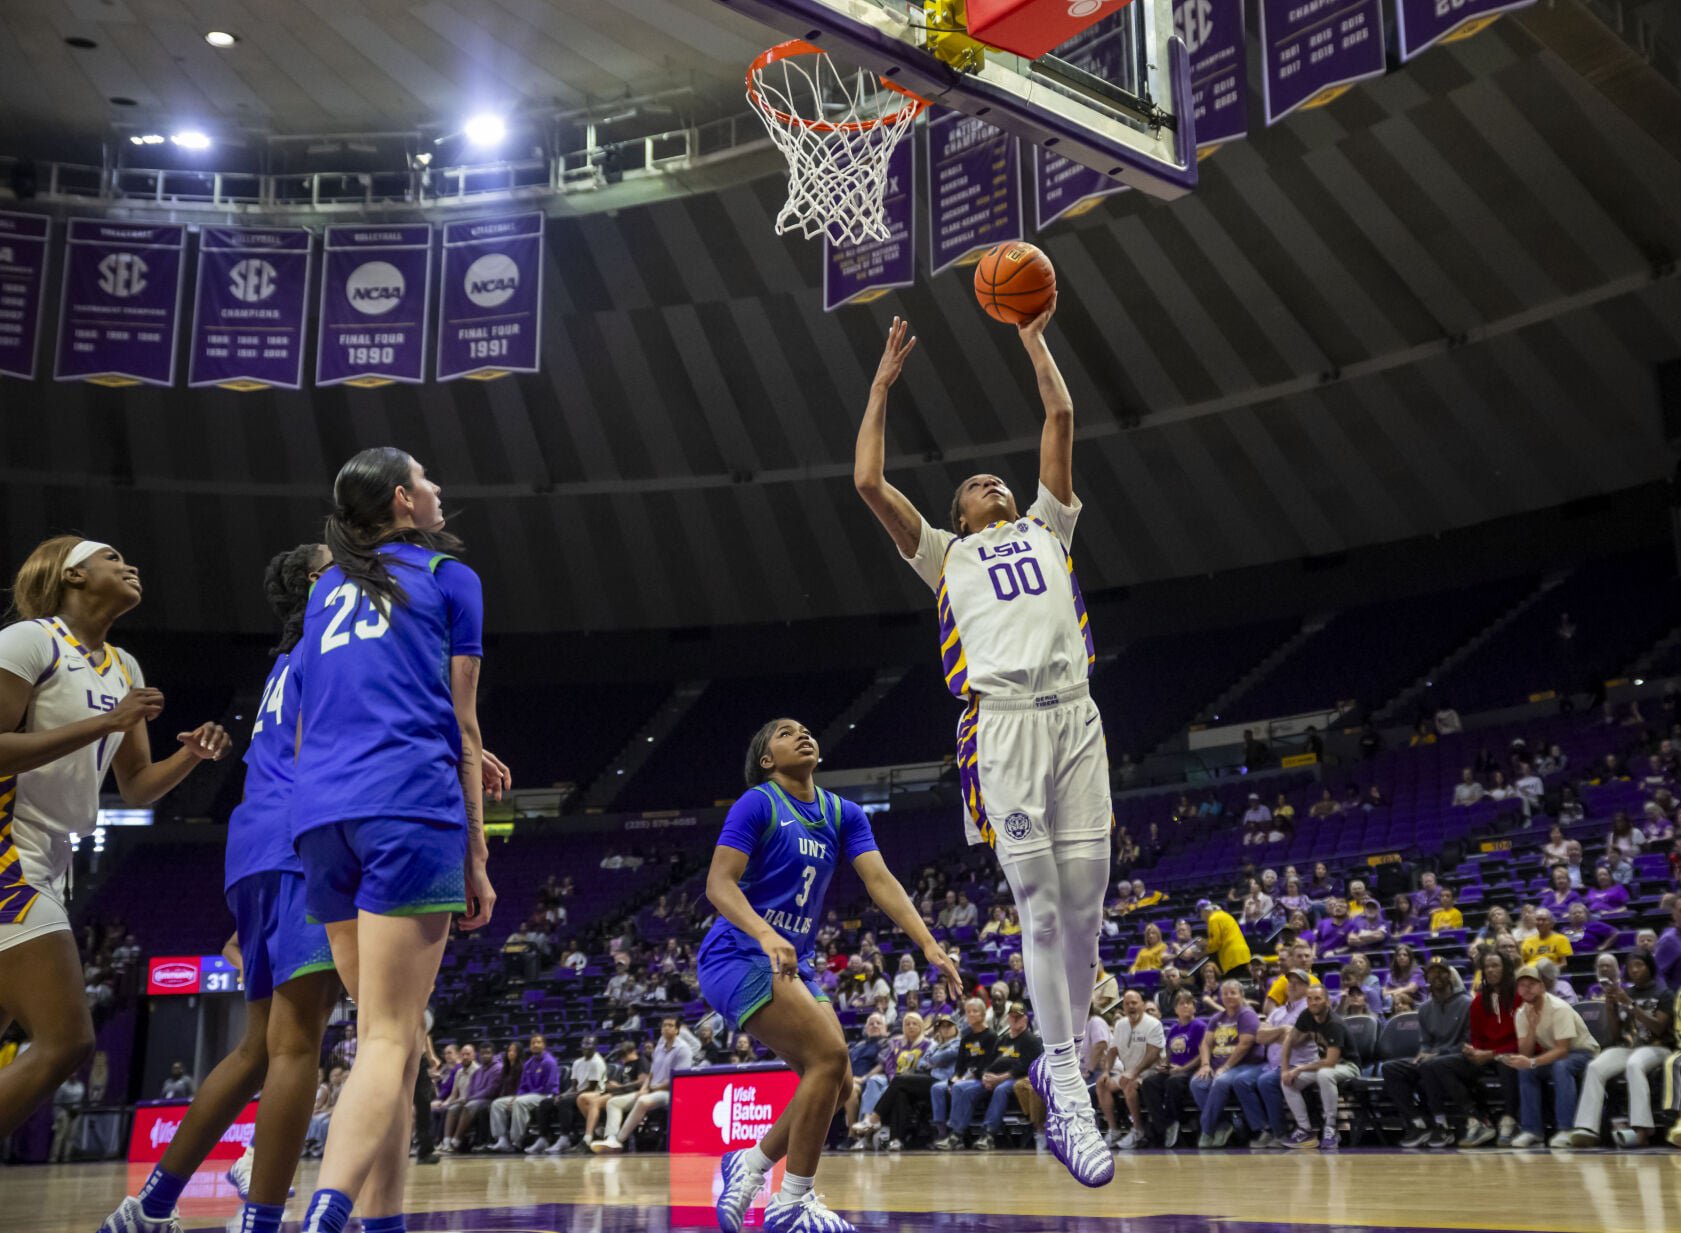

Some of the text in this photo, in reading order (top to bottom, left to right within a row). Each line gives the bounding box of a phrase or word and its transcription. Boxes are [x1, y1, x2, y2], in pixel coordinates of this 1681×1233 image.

[98, 252, 149, 297] SEC
[229, 259, 277, 302] SEC
[352, 286, 401, 301] NCAA
[470, 277, 517, 295] NCAA
[339, 333, 404, 346] FINAL FOUR
[459, 324, 520, 340] FINAL FOUR
[348, 348, 394, 365] 1990
[470, 339, 507, 359] 1991
[978, 540, 1032, 562] LSU
[987, 557, 1047, 601] 00
[321, 582, 392, 655] 23
[251, 664, 290, 741] 24
[798, 837, 827, 859] UNT
[795, 865, 816, 907] 3
[206, 973, 229, 990] 31
[733, 1086, 757, 1102] Visit
[732, 1102, 772, 1121] Baton
